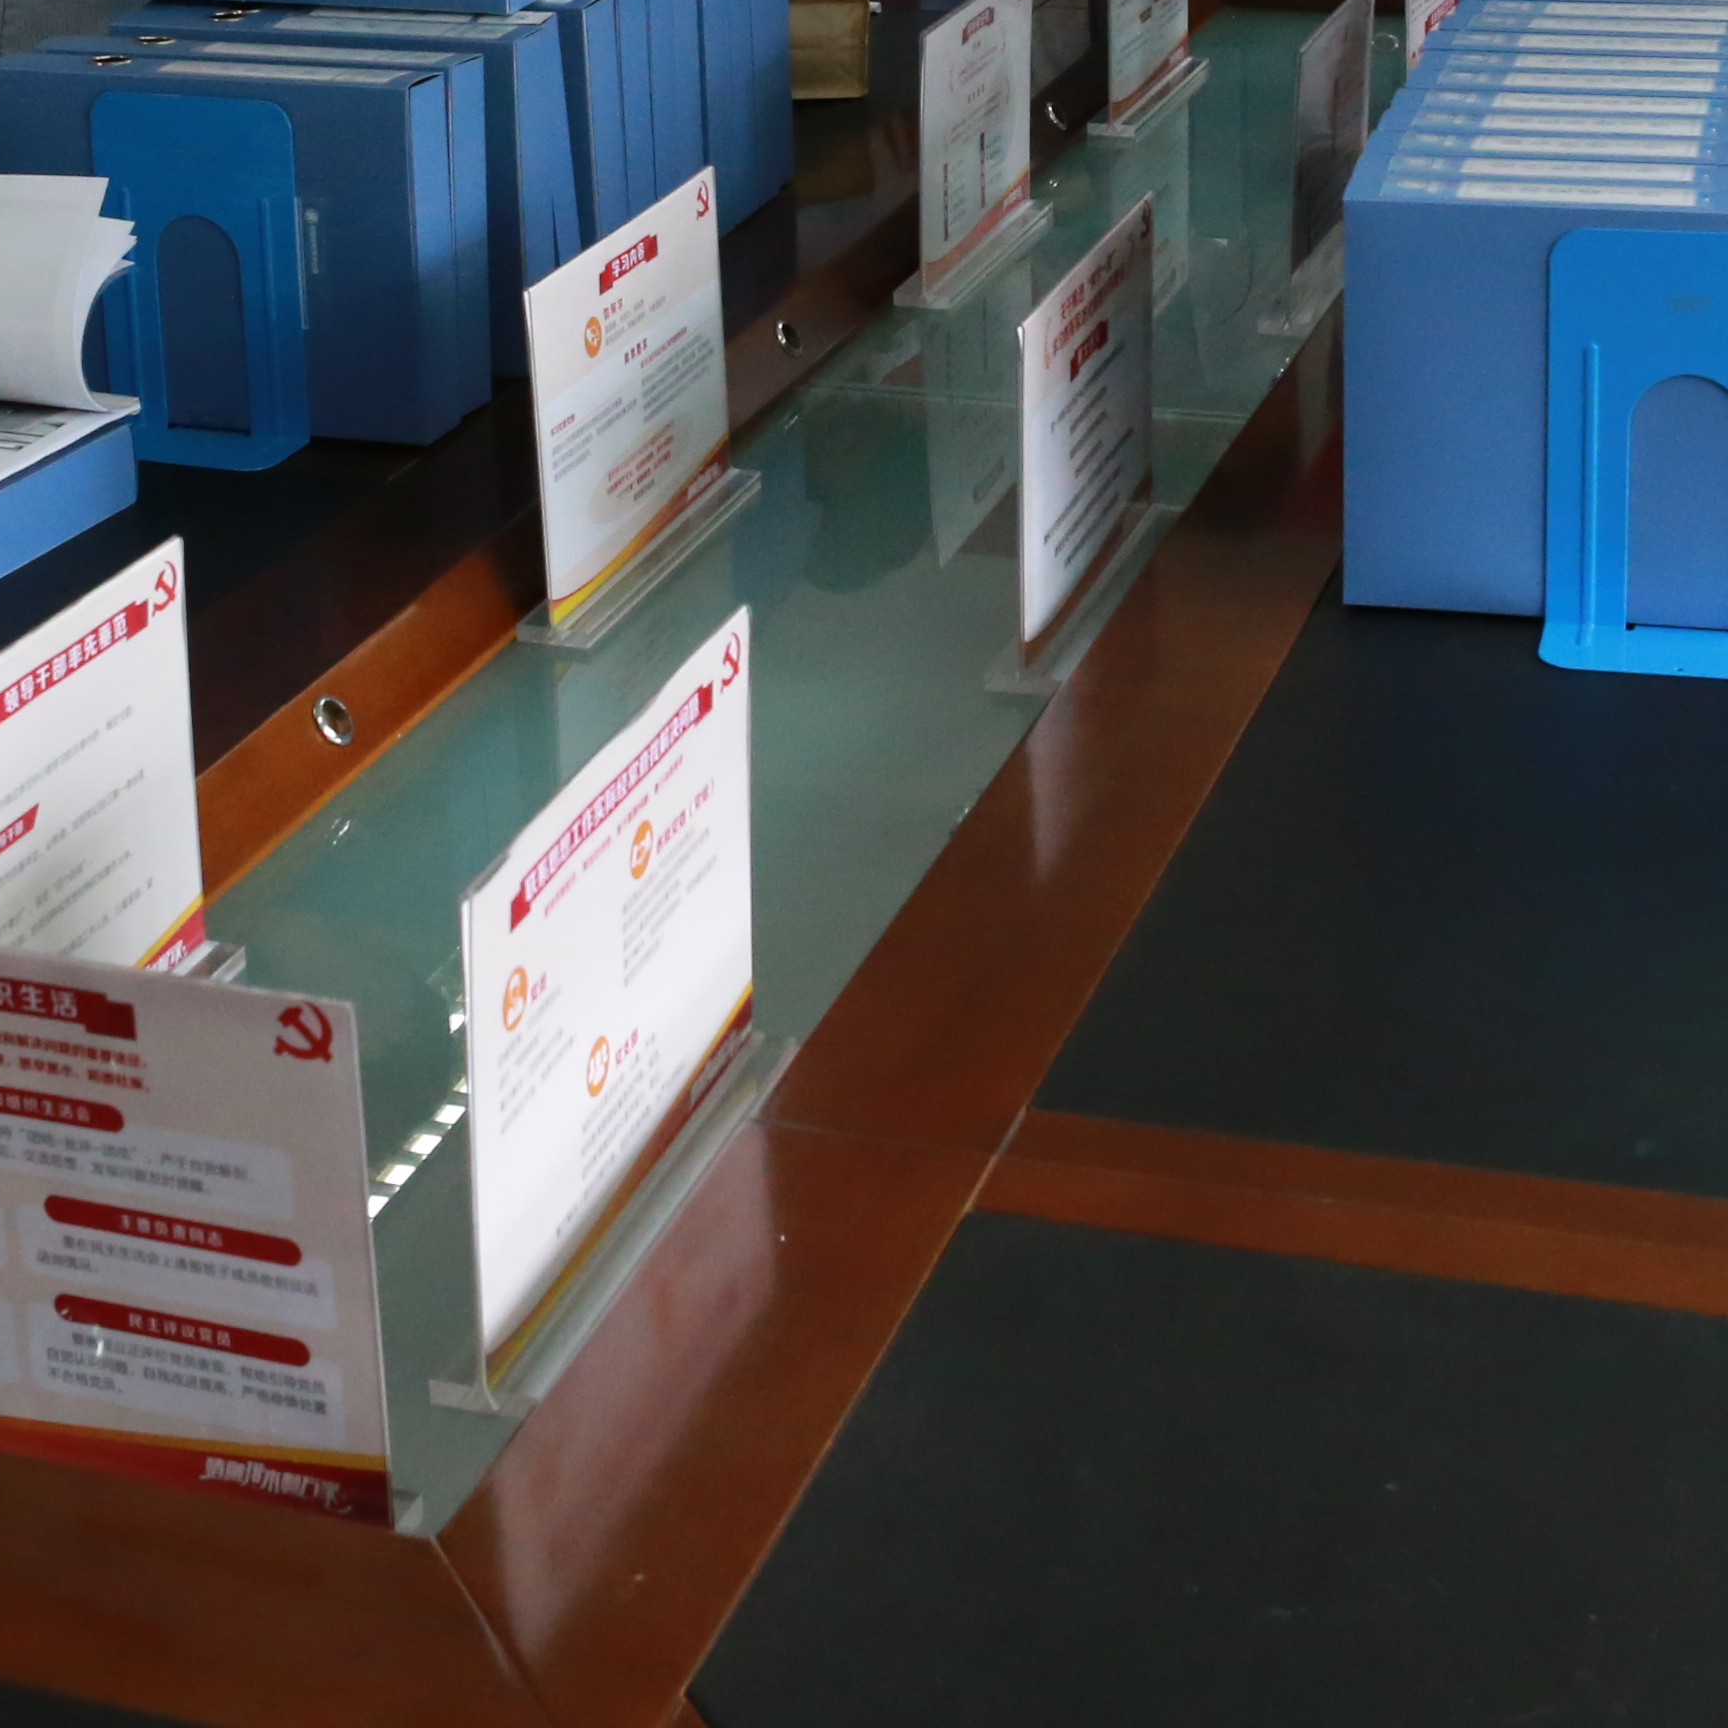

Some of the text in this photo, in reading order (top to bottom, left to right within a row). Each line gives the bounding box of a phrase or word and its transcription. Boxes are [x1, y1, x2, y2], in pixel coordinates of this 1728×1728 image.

[128, 1312, 233, 1348] 民主评议党员
